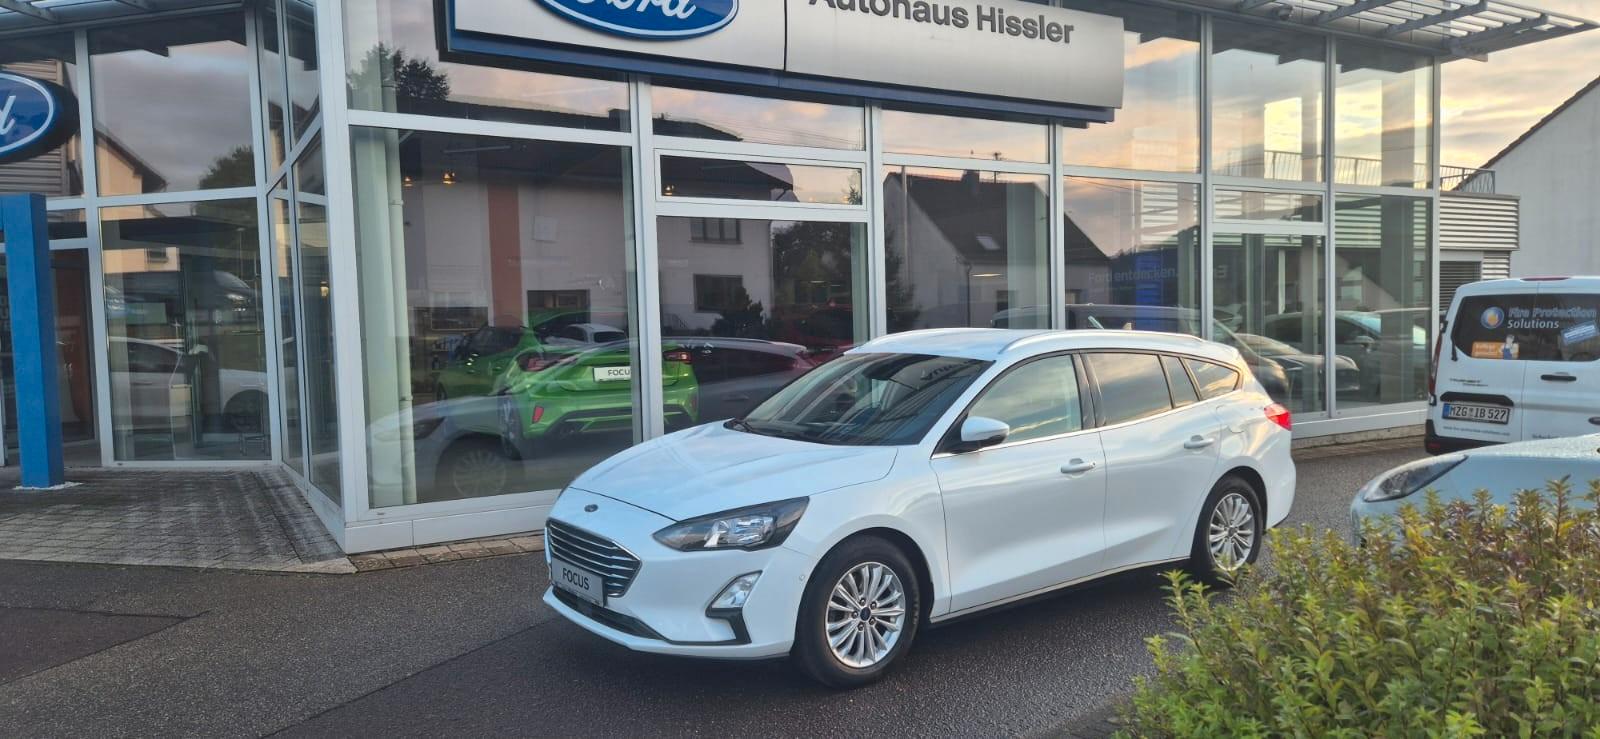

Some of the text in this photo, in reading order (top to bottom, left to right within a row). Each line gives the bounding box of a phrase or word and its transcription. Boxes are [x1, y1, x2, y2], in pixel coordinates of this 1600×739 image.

[808, 0, 1075, 44] utohaus Hissler
[1507, 319, 1560, 329] Solutions
[608, 368, 630, 377] FOCU
[1474, 407, 1486, 418] IB
[1488, 409, 1506, 421] 527
[562, 567, 590, 591] FOCUS
